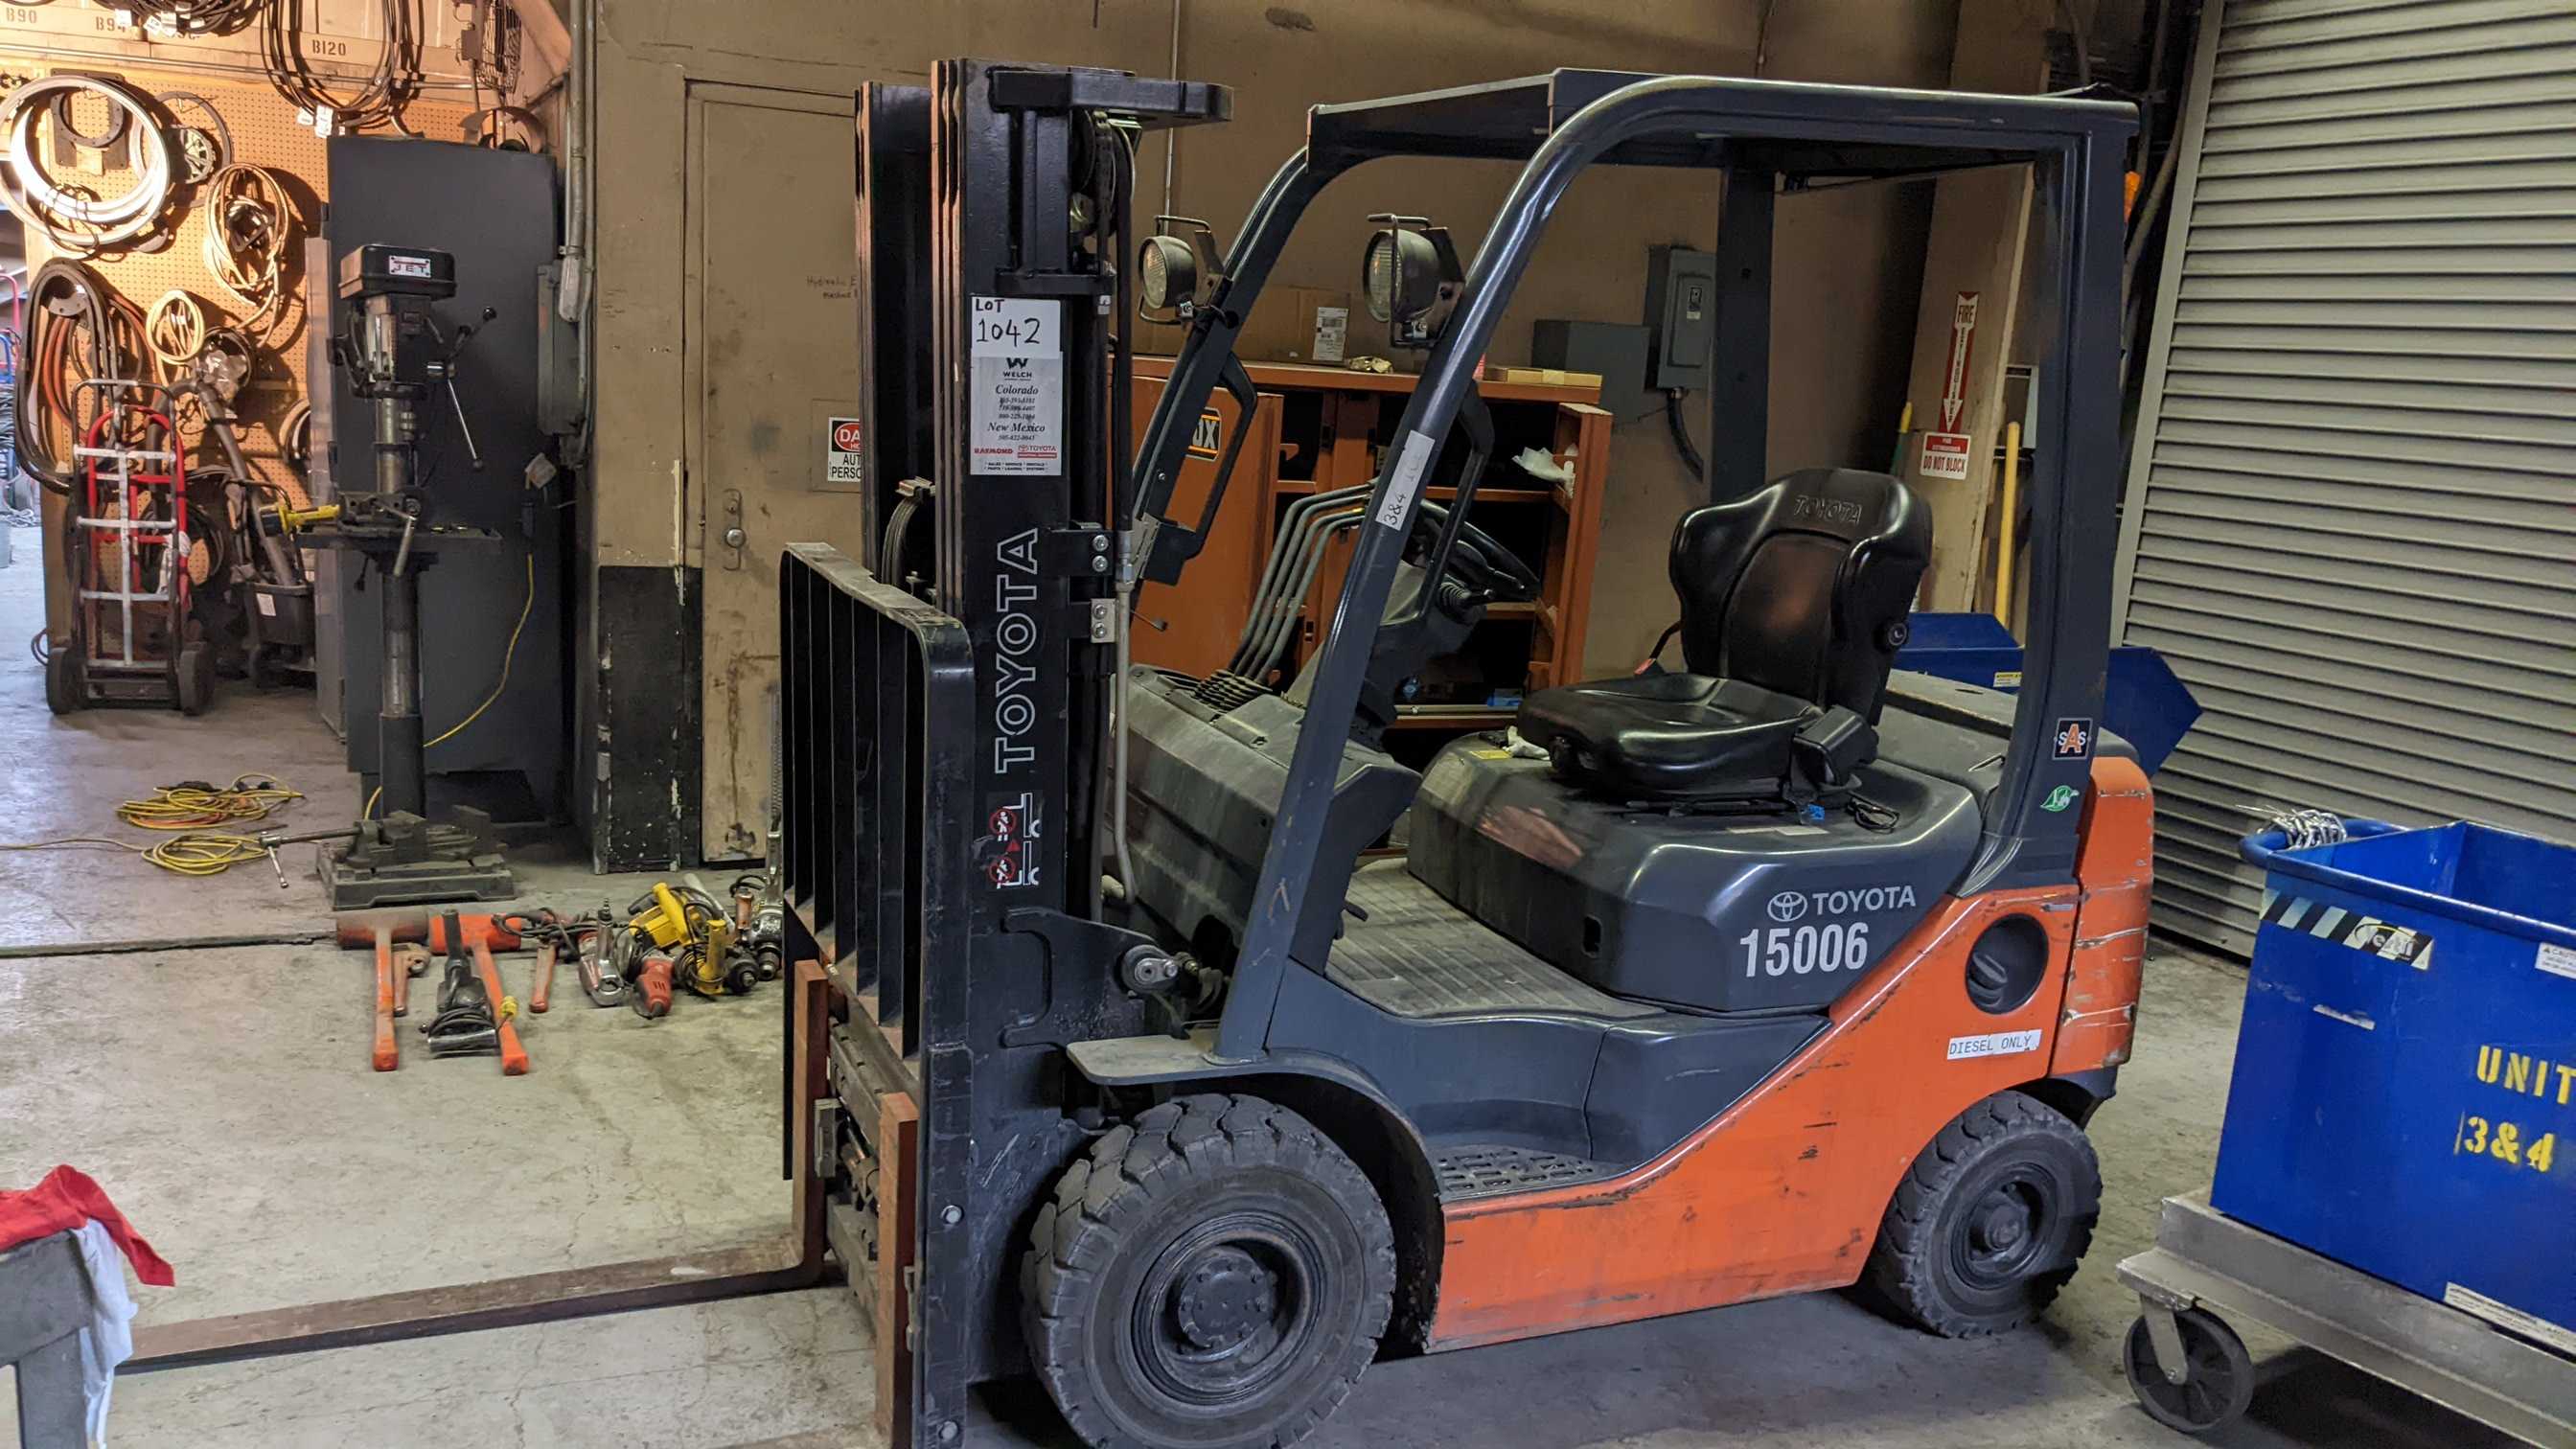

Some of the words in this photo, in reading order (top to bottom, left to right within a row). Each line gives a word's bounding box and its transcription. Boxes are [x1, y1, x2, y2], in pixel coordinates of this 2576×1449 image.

[6, 7, 37, 24] B90
[312, 39, 346, 56] B120
[393, 264, 426, 273] JET
[976, 298, 1004, 313] LOT
[1958, 305, 1974, 324] FIRE
[977, 317, 1040, 347] 1042
[996, 384, 1040, 396] Colorado
[987, 422, 1009, 432] New
[1011, 422, 1046, 433] Mexico
[843, 453, 862, 466] AUT
[1923, 455, 1932, 470] DO
[1933, 456, 1945, 471] NOT
[1946, 457, 1965, 473] BLOCK
[831, 466, 863, 479] PERSO
[1384, 493, 1406, 525] 3&4
[1794, 494, 1862, 524] TOYOTA
[995, 528, 1038, 773] TOYOTA
[2058, 724, 2087, 754] SAS
[1812, 885, 1916, 915] TOYOTA
[1739, 922, 1869, 978] 15006
[1949, 1040, 1993, 1055] DIESEL
[2000, 1035, 2032, 1049] ONLY
[2477, 1046, 2576, 1104] UNIT
[2464, 1116, 2555, 1172] 3&4
